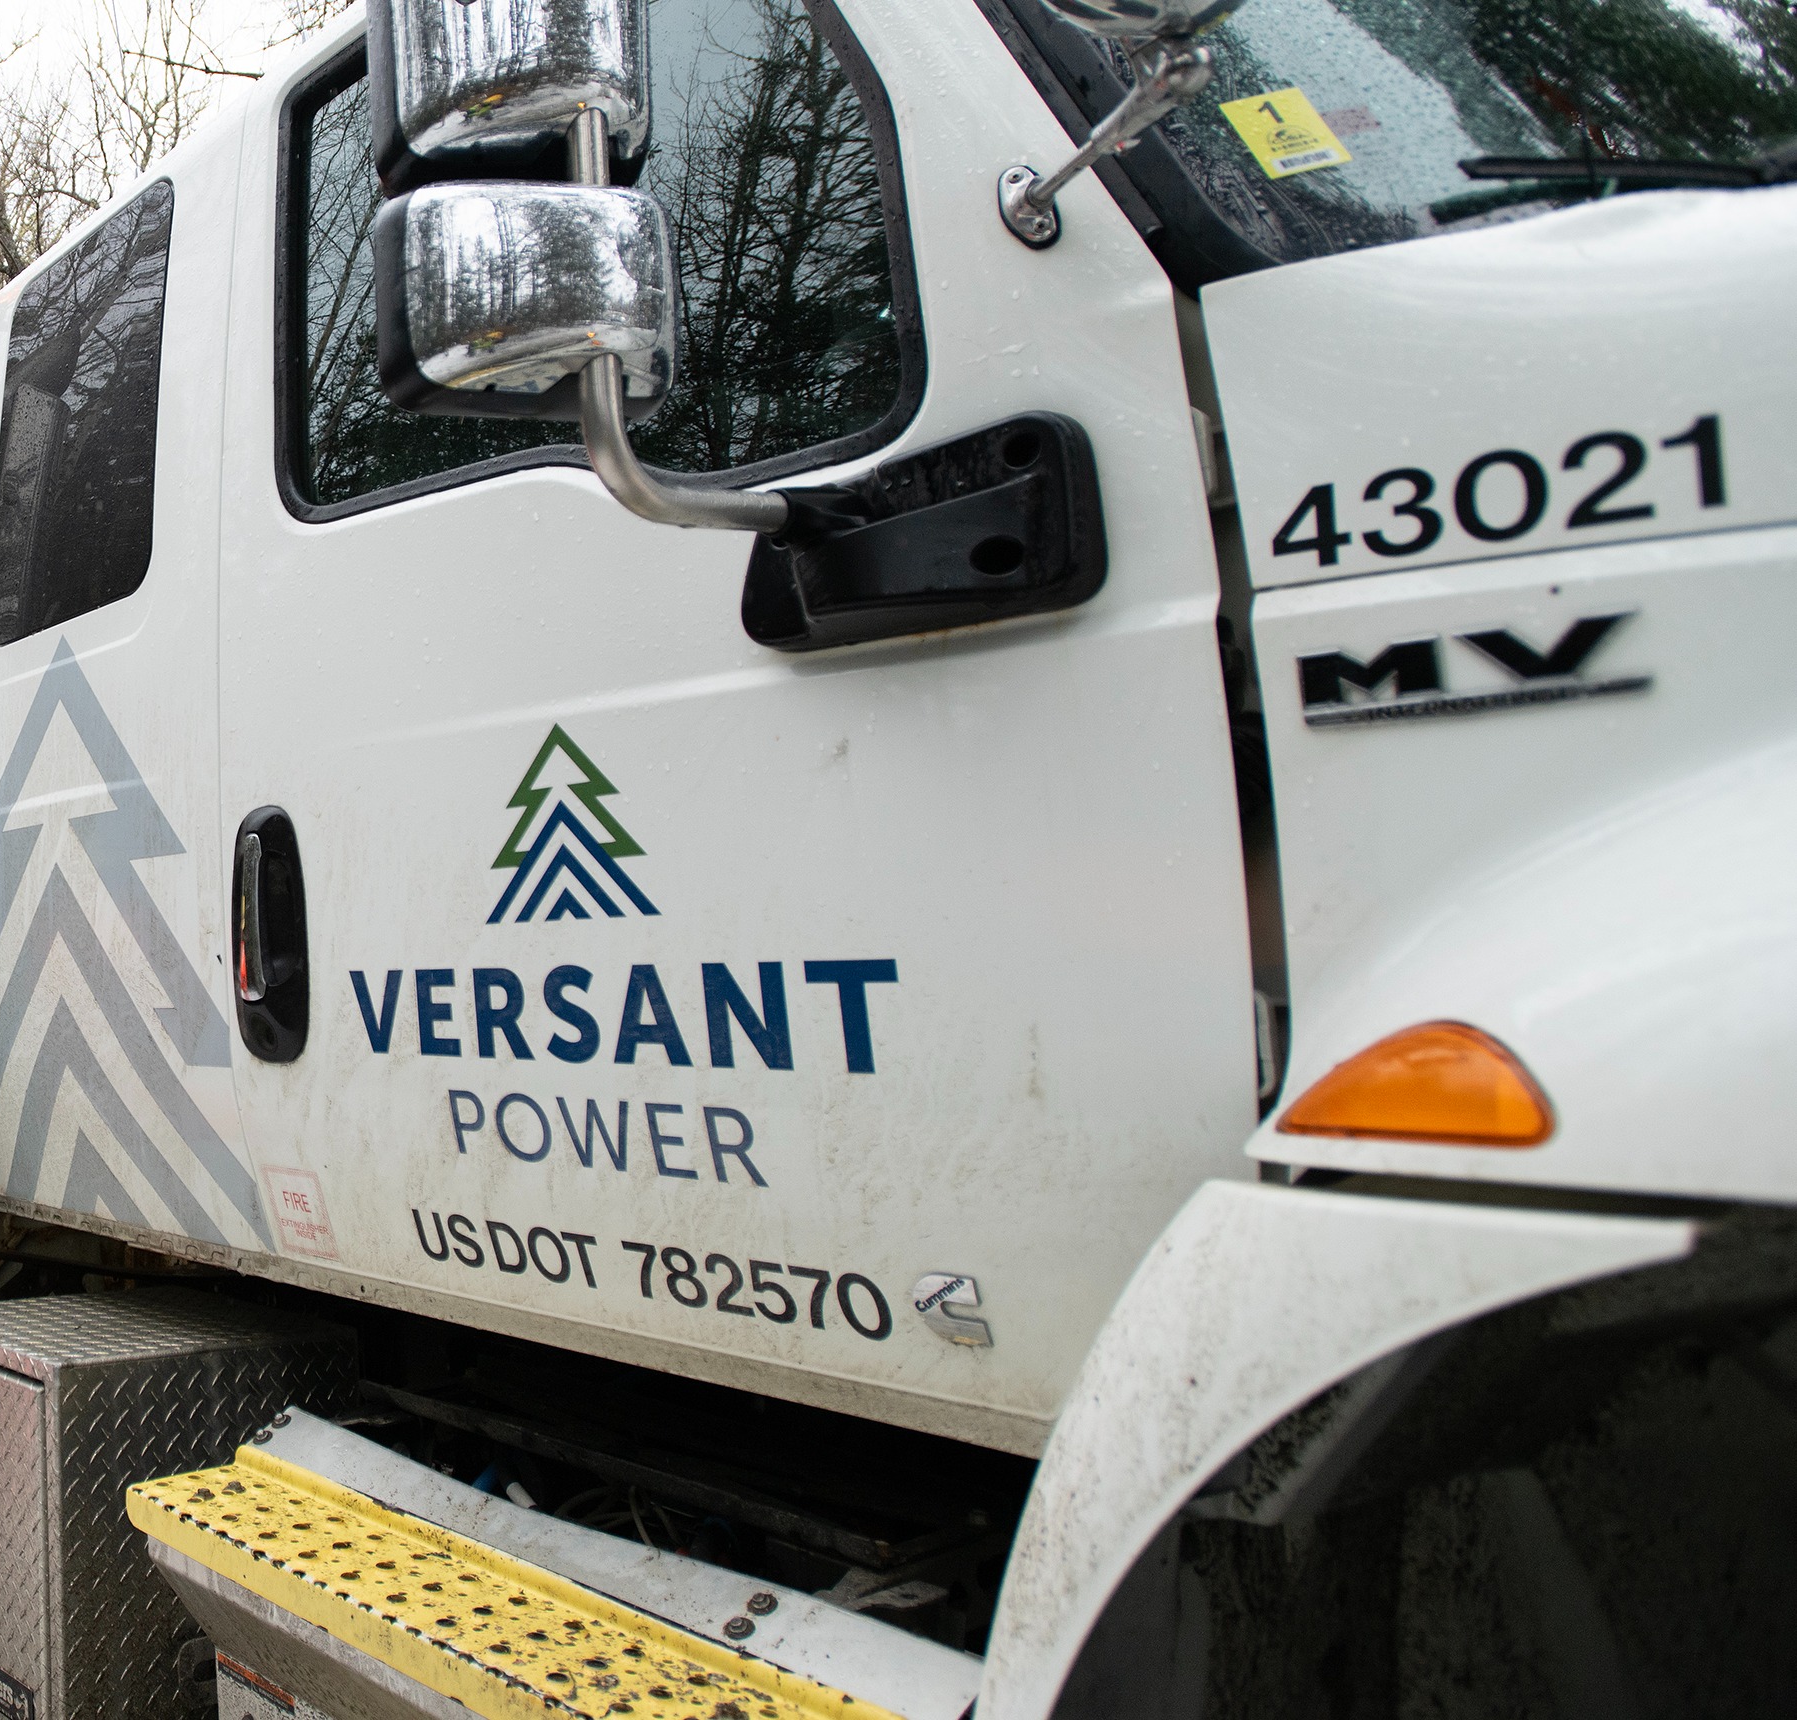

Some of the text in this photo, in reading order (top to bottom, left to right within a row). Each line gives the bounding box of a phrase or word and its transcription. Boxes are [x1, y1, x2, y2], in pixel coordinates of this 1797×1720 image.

[1258, 101, 1285, 123] 1
[1272, 414, 1728, 567] 43021
[1297, 610, 1641, 706] MV
[349, 958, 900, 1075] VERSANT
[448, 1088, 769, 1188] POWER
[281, 1218, 329, 1235] EXTINGUISHER
[282, 1191, 312, 1213] FIRE
[295, 1229, 317, 1241] INSIDE
[621, 1240, 894, 1342] 782570
[914, 1278, 966, 1313] Cummins
